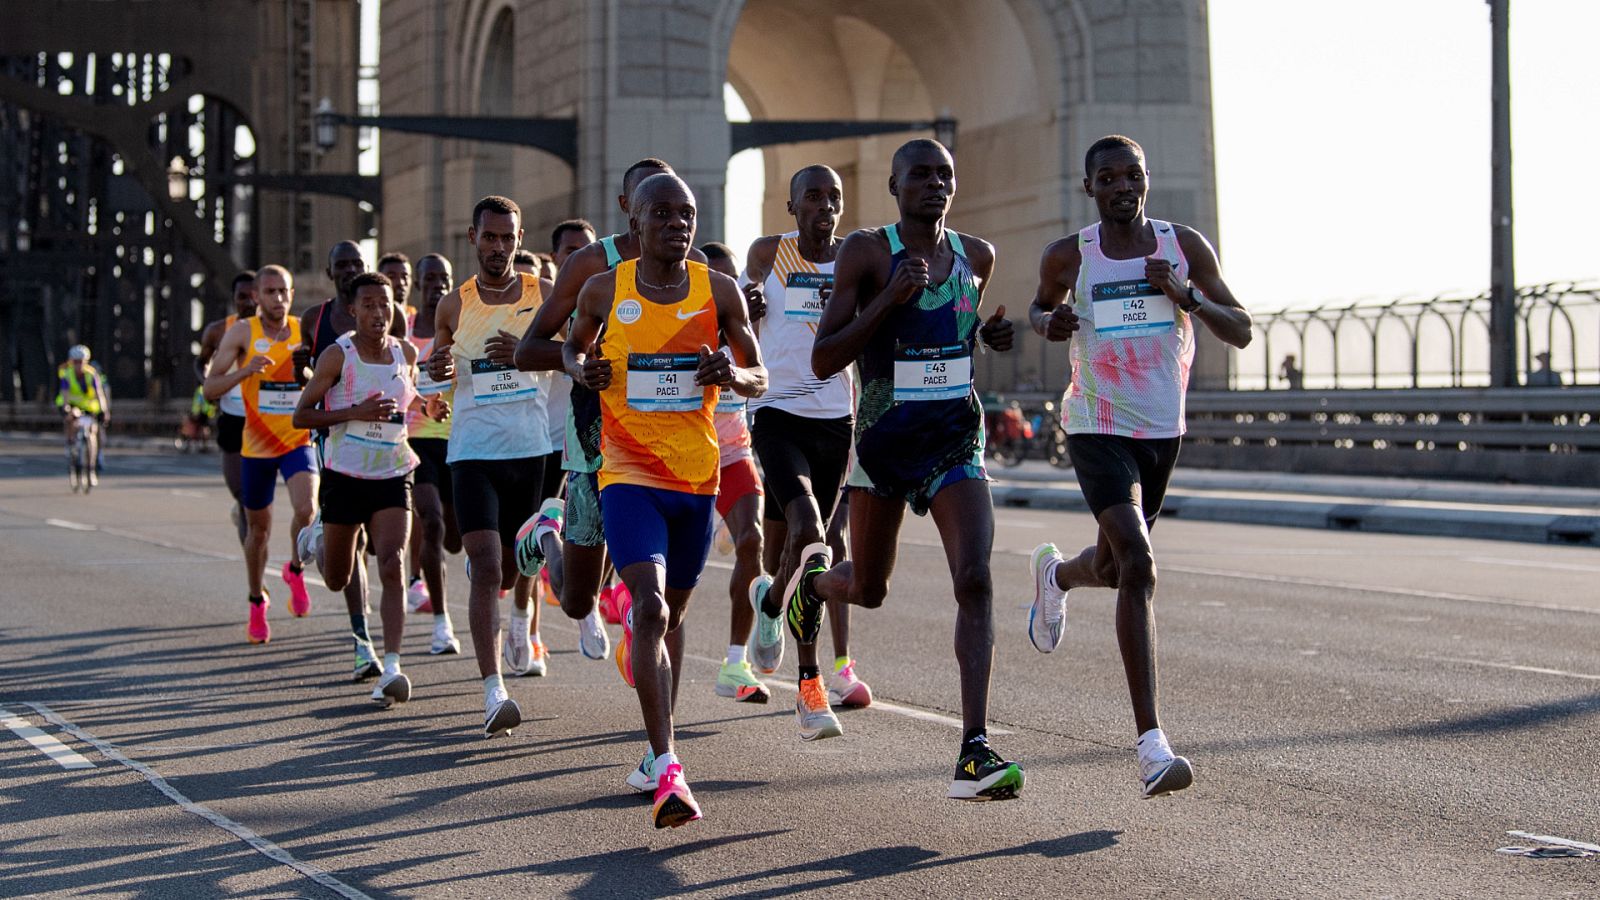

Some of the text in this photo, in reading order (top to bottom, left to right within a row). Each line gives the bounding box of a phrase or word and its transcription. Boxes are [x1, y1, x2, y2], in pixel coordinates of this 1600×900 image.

[1123, 299, 1145, 310] E42
[1122, 312, 1147, 322] PACE2
[925, 362, 946, 373] E43
[496, 372, 512, 381] E15
[658, 373, 677, 384] E41
[923, 375, 947, 385] PACE3
[491, 382, 520, 392] GETANEH
[656, 387, 679, 396] PACE1
